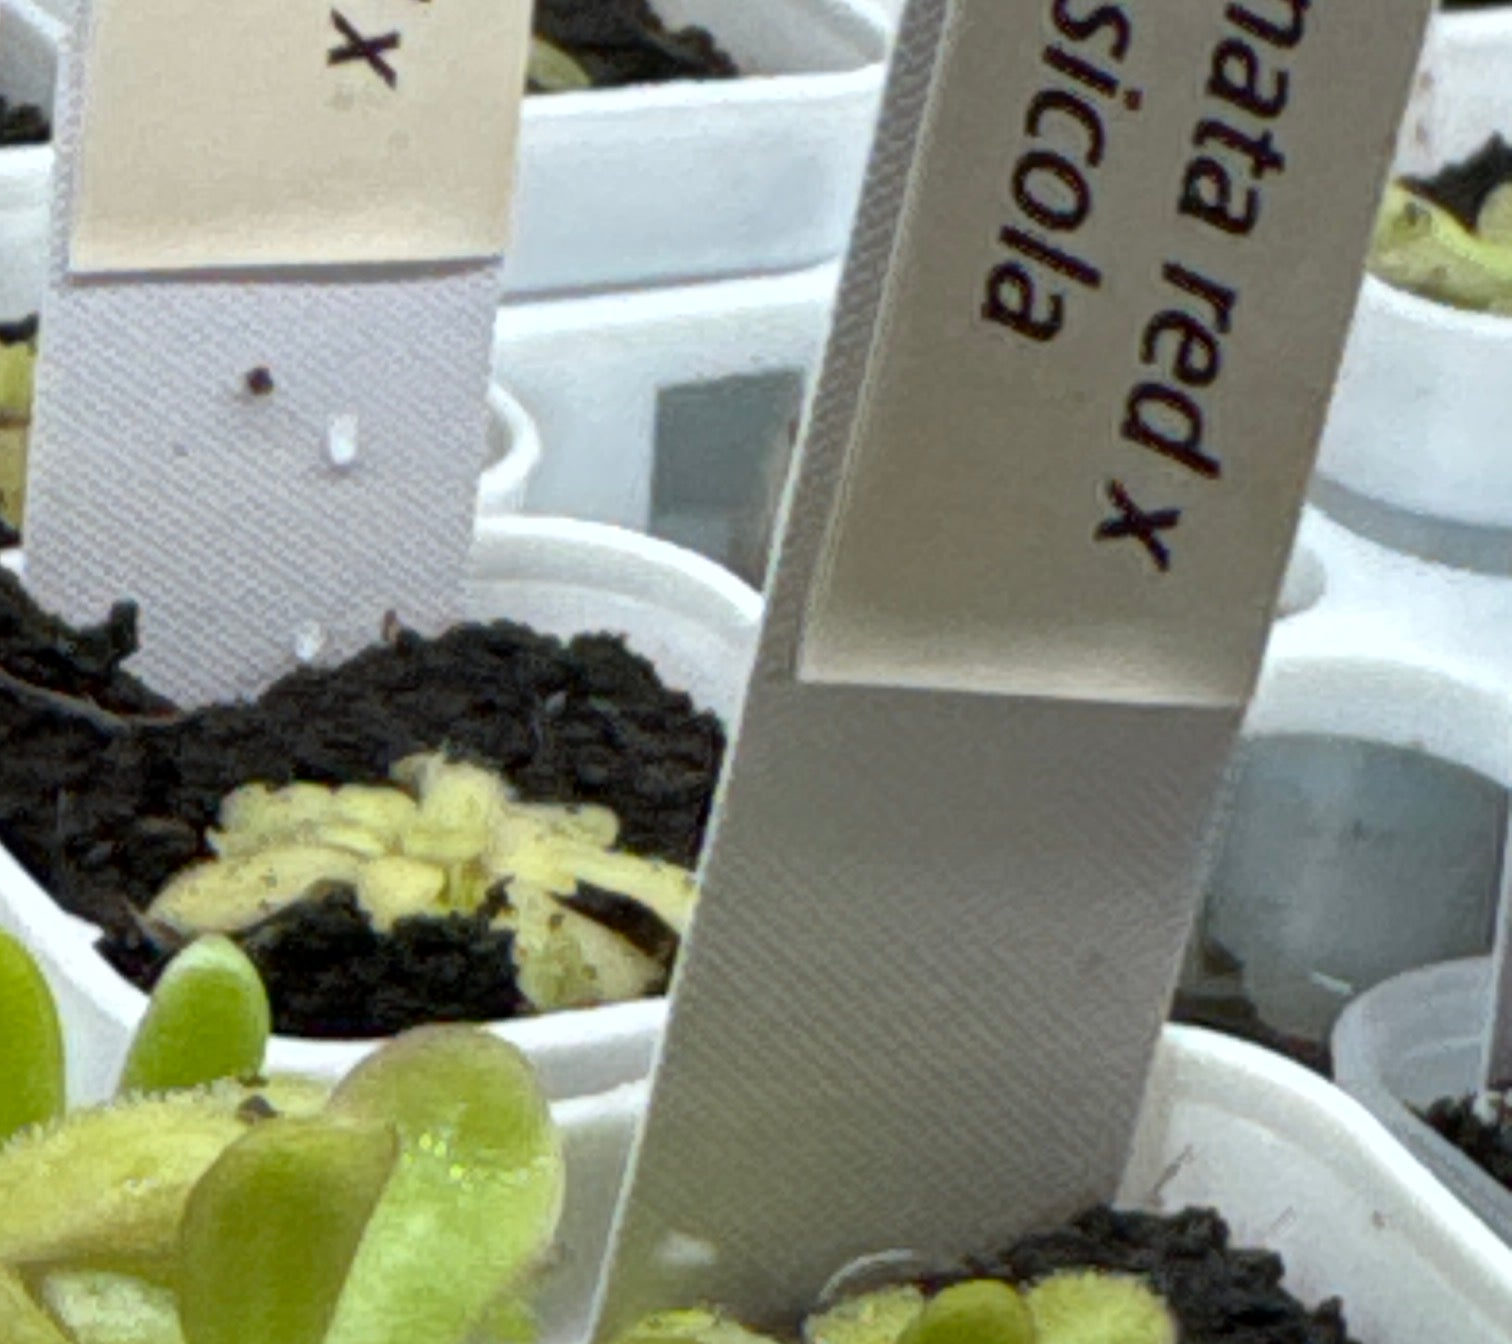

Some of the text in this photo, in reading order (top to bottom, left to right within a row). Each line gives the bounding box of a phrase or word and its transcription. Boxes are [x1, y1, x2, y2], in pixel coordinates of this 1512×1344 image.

[328, 10, 400, 88] x
[1120, 263, 1236, 479] red
[1095, 480, 1180, 572] x
